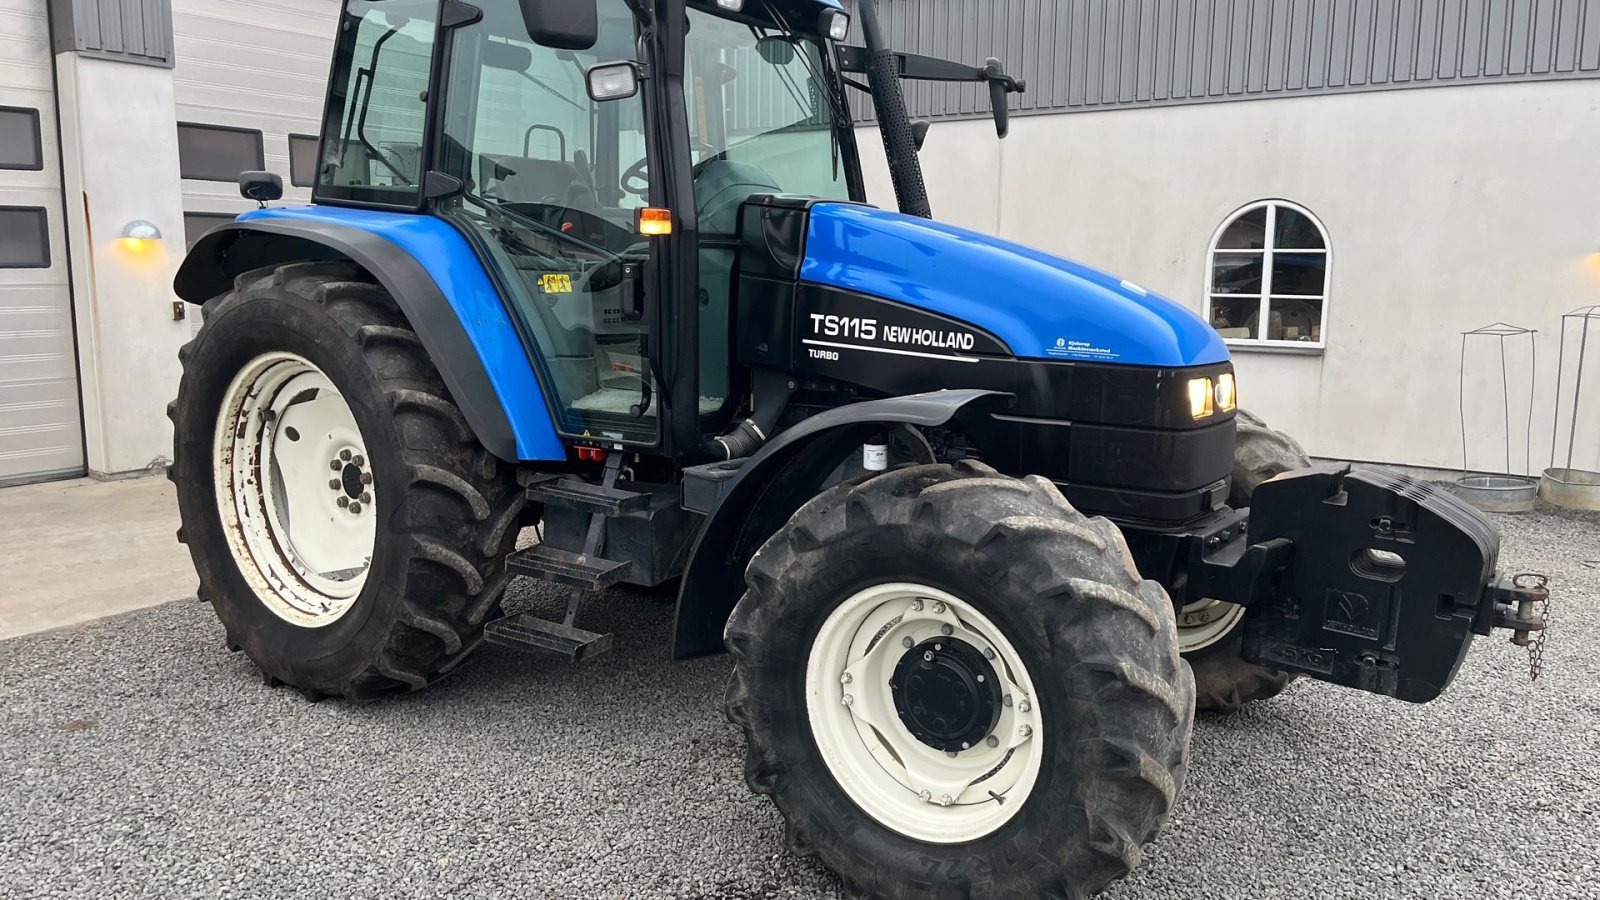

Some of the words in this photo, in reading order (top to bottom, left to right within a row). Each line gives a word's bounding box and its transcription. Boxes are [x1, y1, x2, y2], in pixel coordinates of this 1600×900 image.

[810, 313, 877, 340] TS115
[883, 325, 912, 343] NEW
[912, 328, 974, 350] HOLLAND
[808, 348, 839, 361] TURBO
